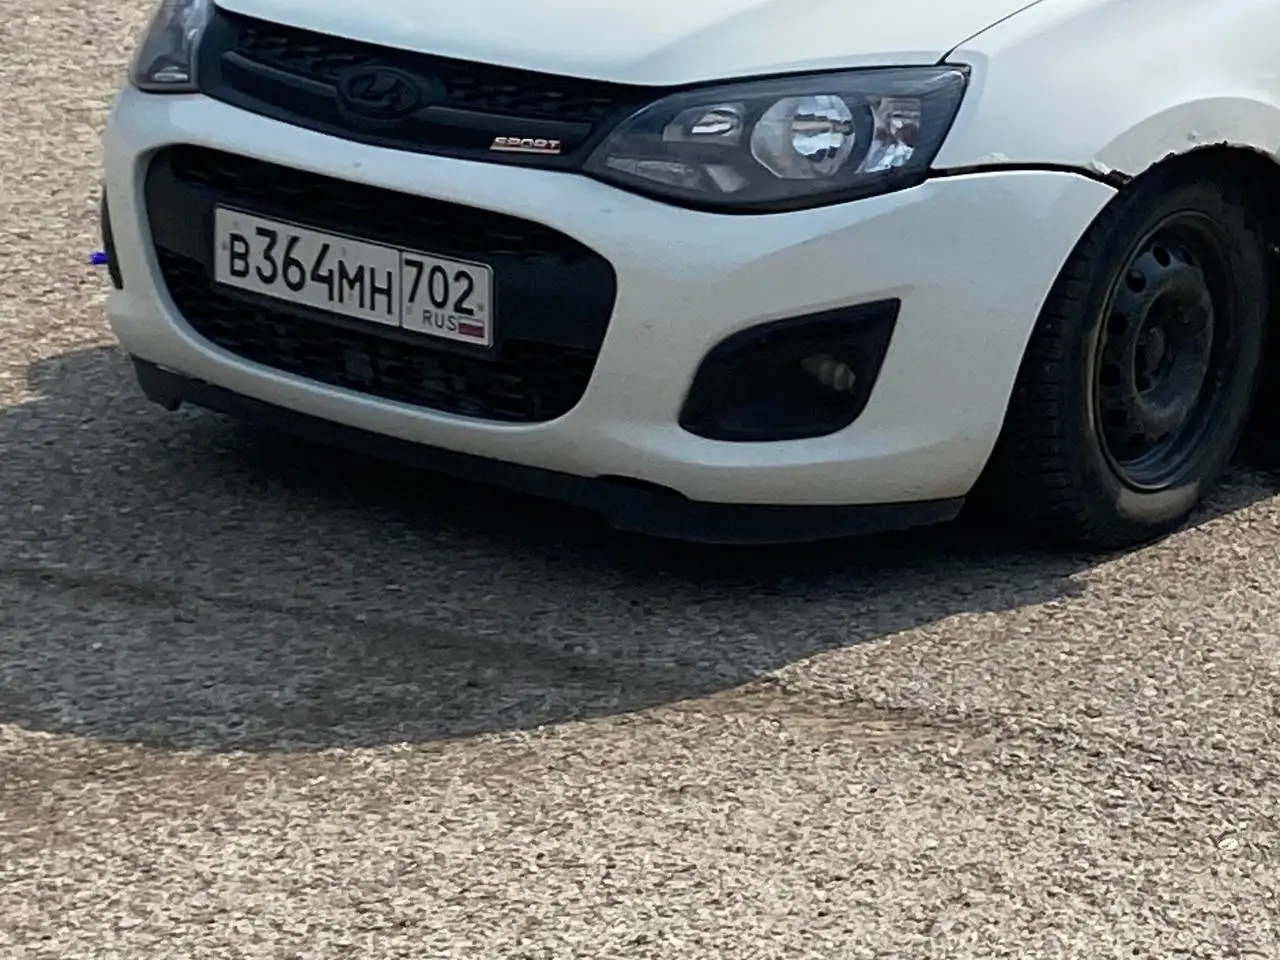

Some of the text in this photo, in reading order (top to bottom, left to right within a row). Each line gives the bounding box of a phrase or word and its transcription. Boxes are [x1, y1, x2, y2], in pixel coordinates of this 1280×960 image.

[494, 136, 561, 149] SPORT
[229, 227, 477, 316] В364МН 702
[422, 309, 458, 333] RUS
